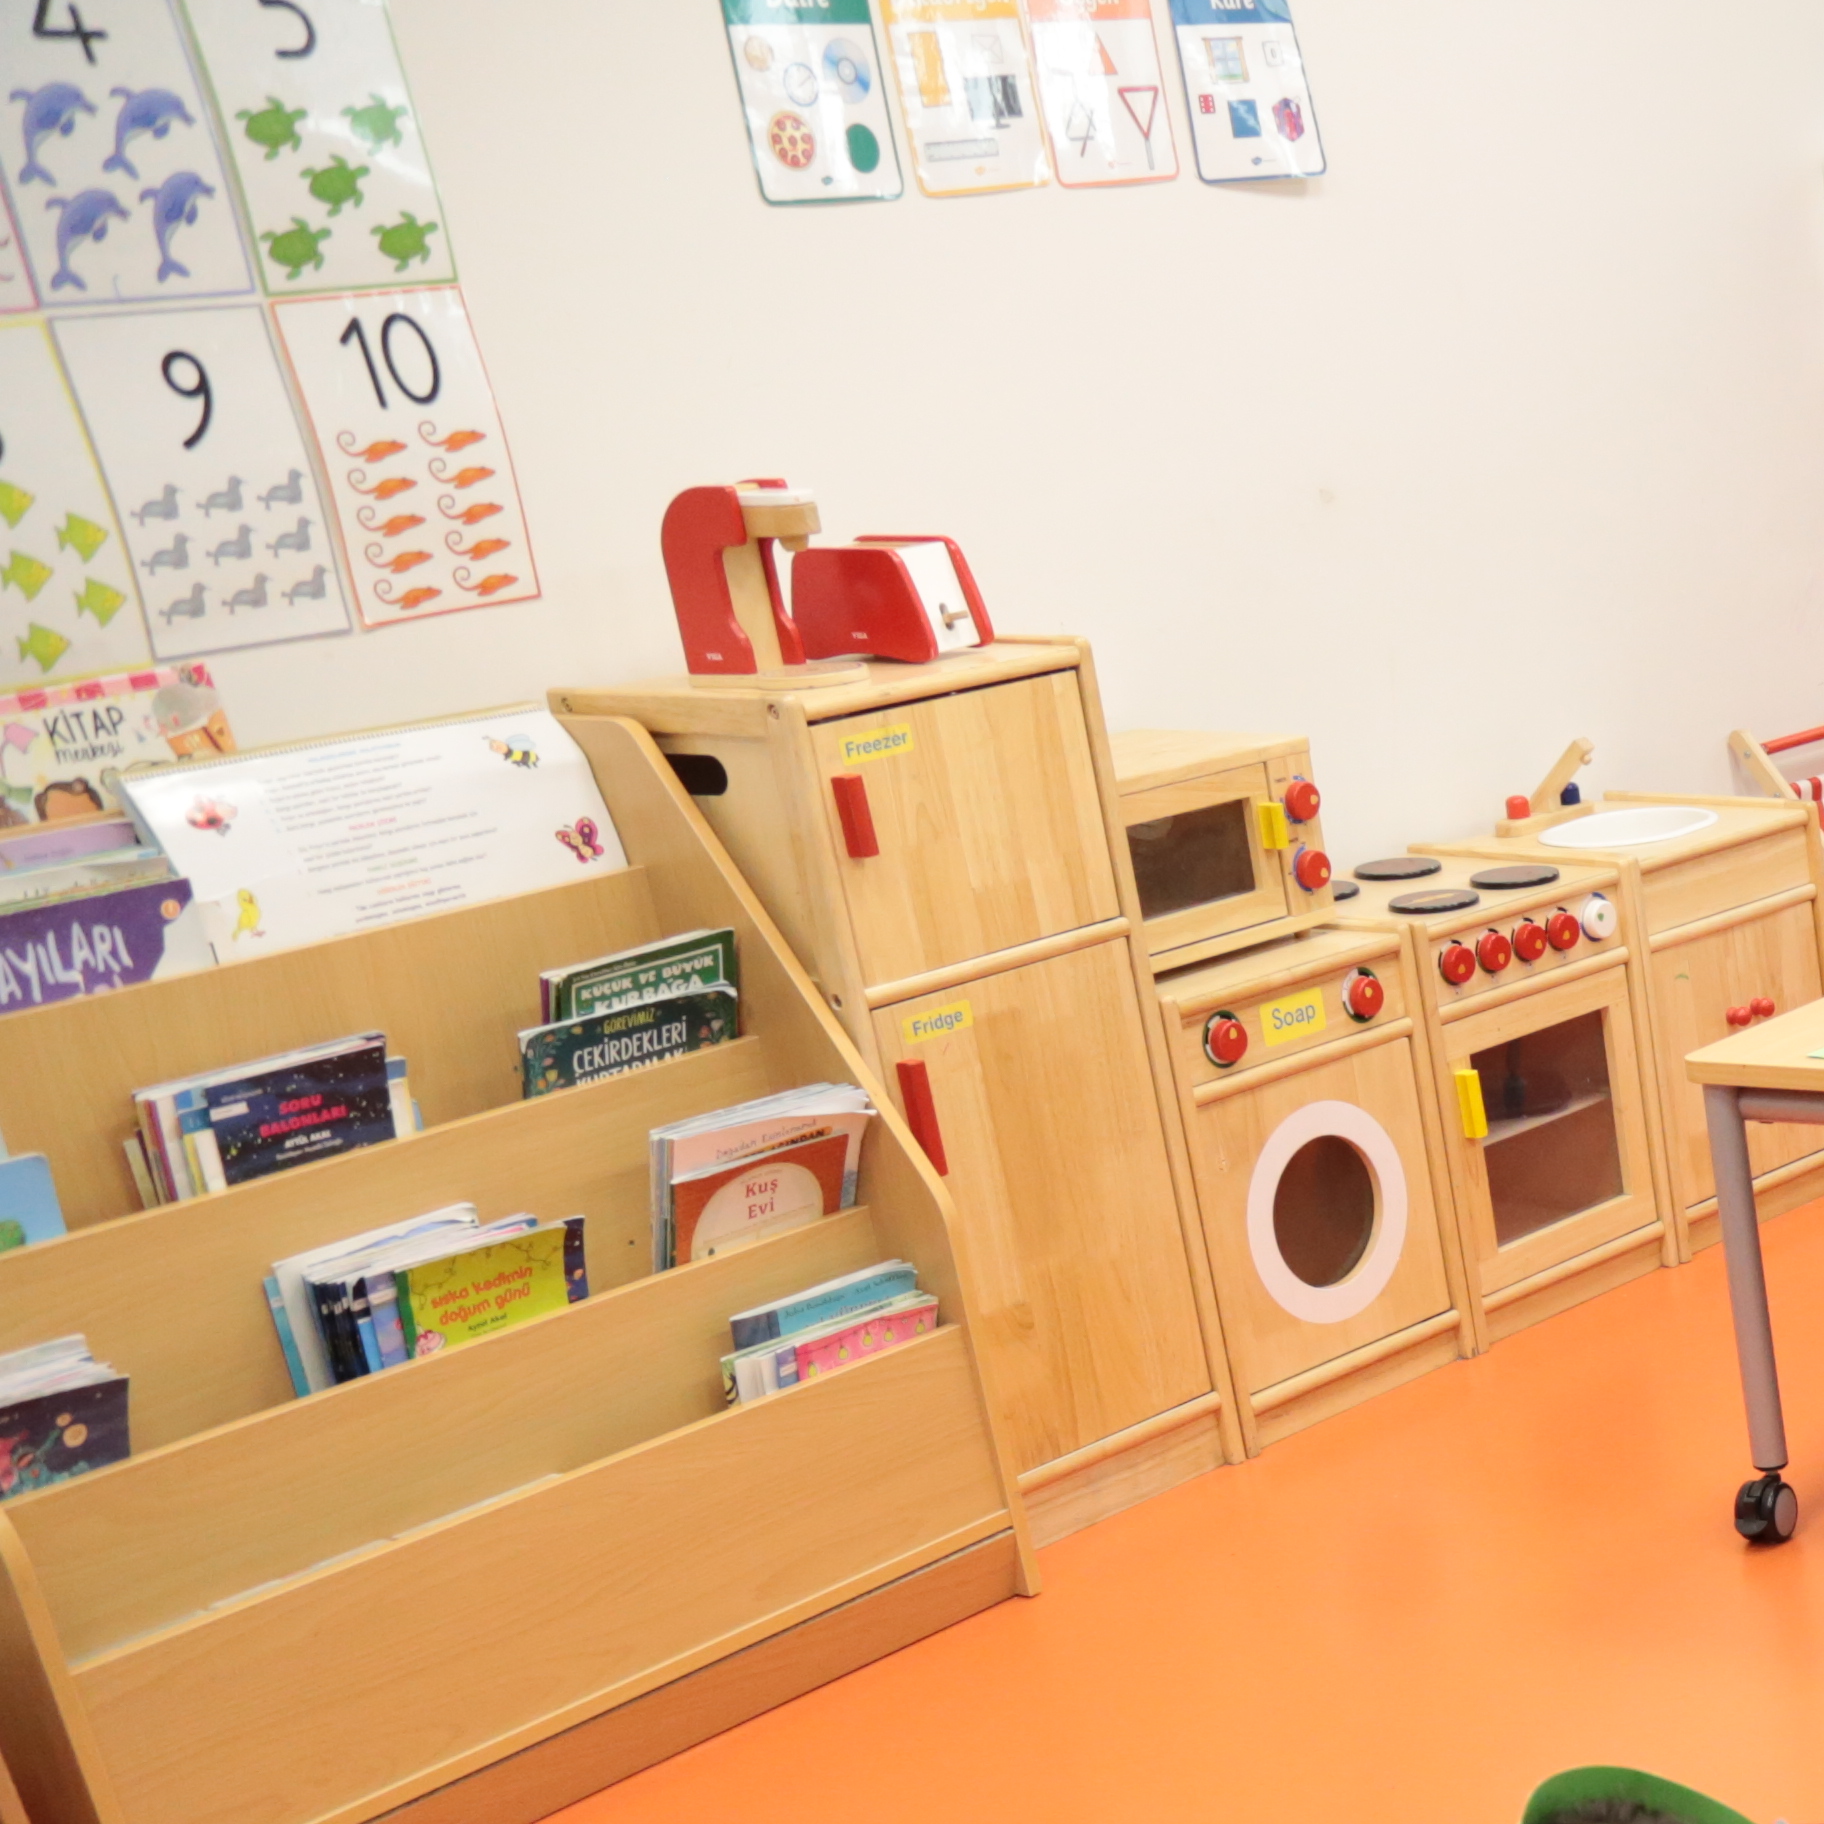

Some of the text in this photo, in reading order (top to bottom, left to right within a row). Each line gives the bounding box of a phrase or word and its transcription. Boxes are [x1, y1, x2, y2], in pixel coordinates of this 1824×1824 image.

[340, 313, 440, 409] 10
[162, 350, 213, 450] 9
[43, 705, 123, 745] KİTAP
[844, 732, 907, 758] Freezer
[639, 969, 656, 984] VE
[912, 1010, 964, 1036] Fridge
[1271, 1004, 1316, 1030] Soap
[573, 1015, 687, 1078] ÇEKİRDEKLERİ
[745, 1178, 779, 1199] Kuş
[747, 1197, 775, 1220] Evi
